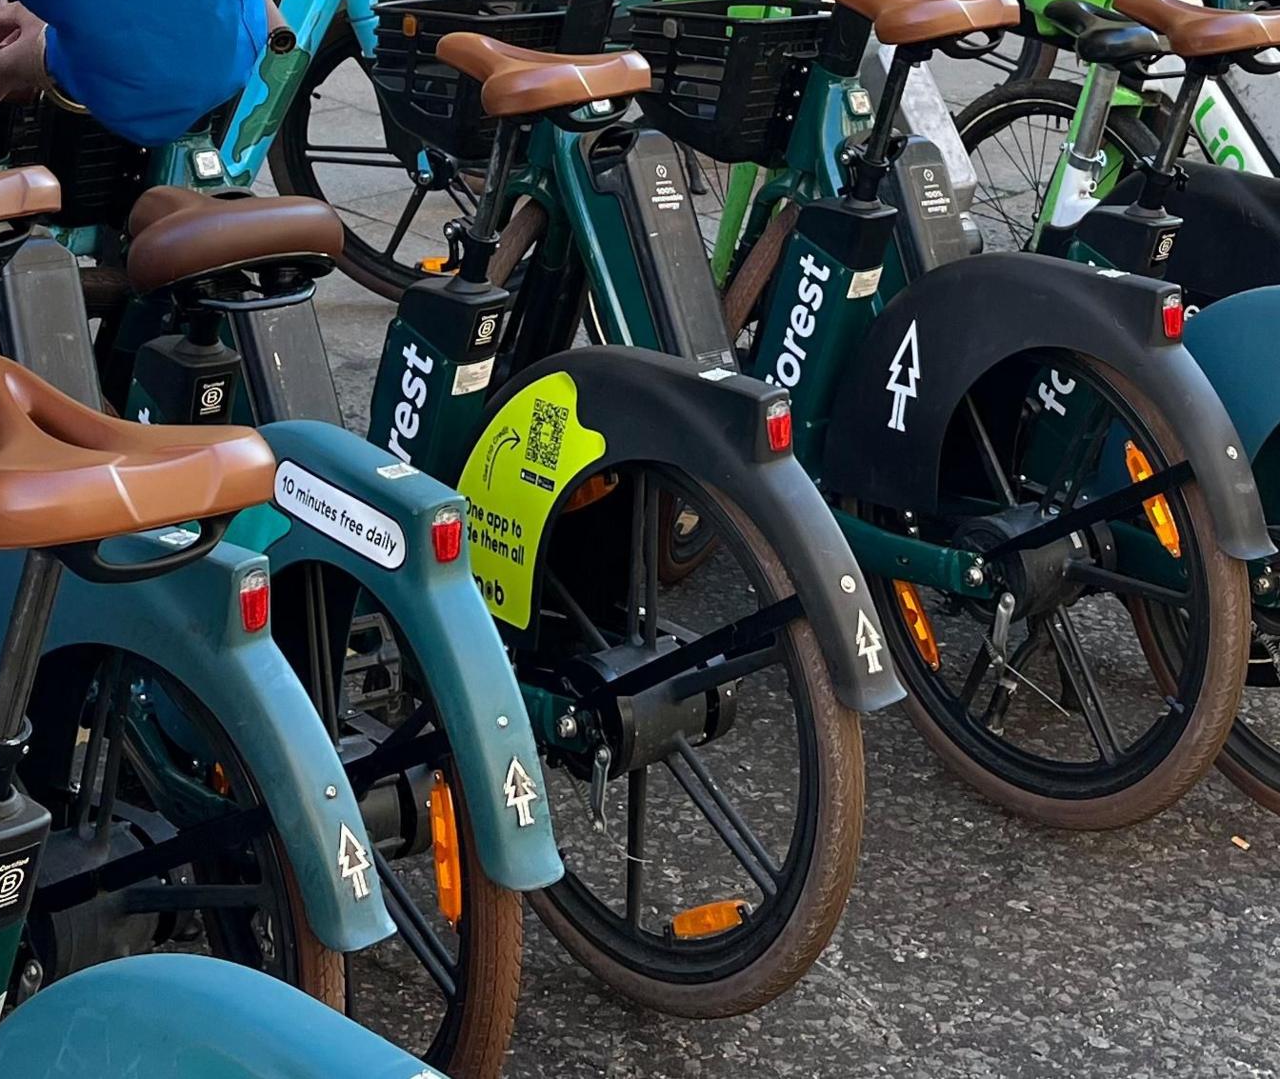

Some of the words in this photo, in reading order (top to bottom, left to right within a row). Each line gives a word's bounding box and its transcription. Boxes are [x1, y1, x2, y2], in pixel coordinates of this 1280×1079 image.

[766, 253, 830, 388] orest
[388, 343, 433, 464] rest
[282, 476, 294, 495] 10
[296, 484, 337, 522] minutes
[340, 510, 363, 536] free
[366, 526, 397, 557] daily
[481, 528, 508, 558] them
[511, 544, 524, 566] all
[487, 511, 508, 537] app
[512, 519, 522, 538] to
